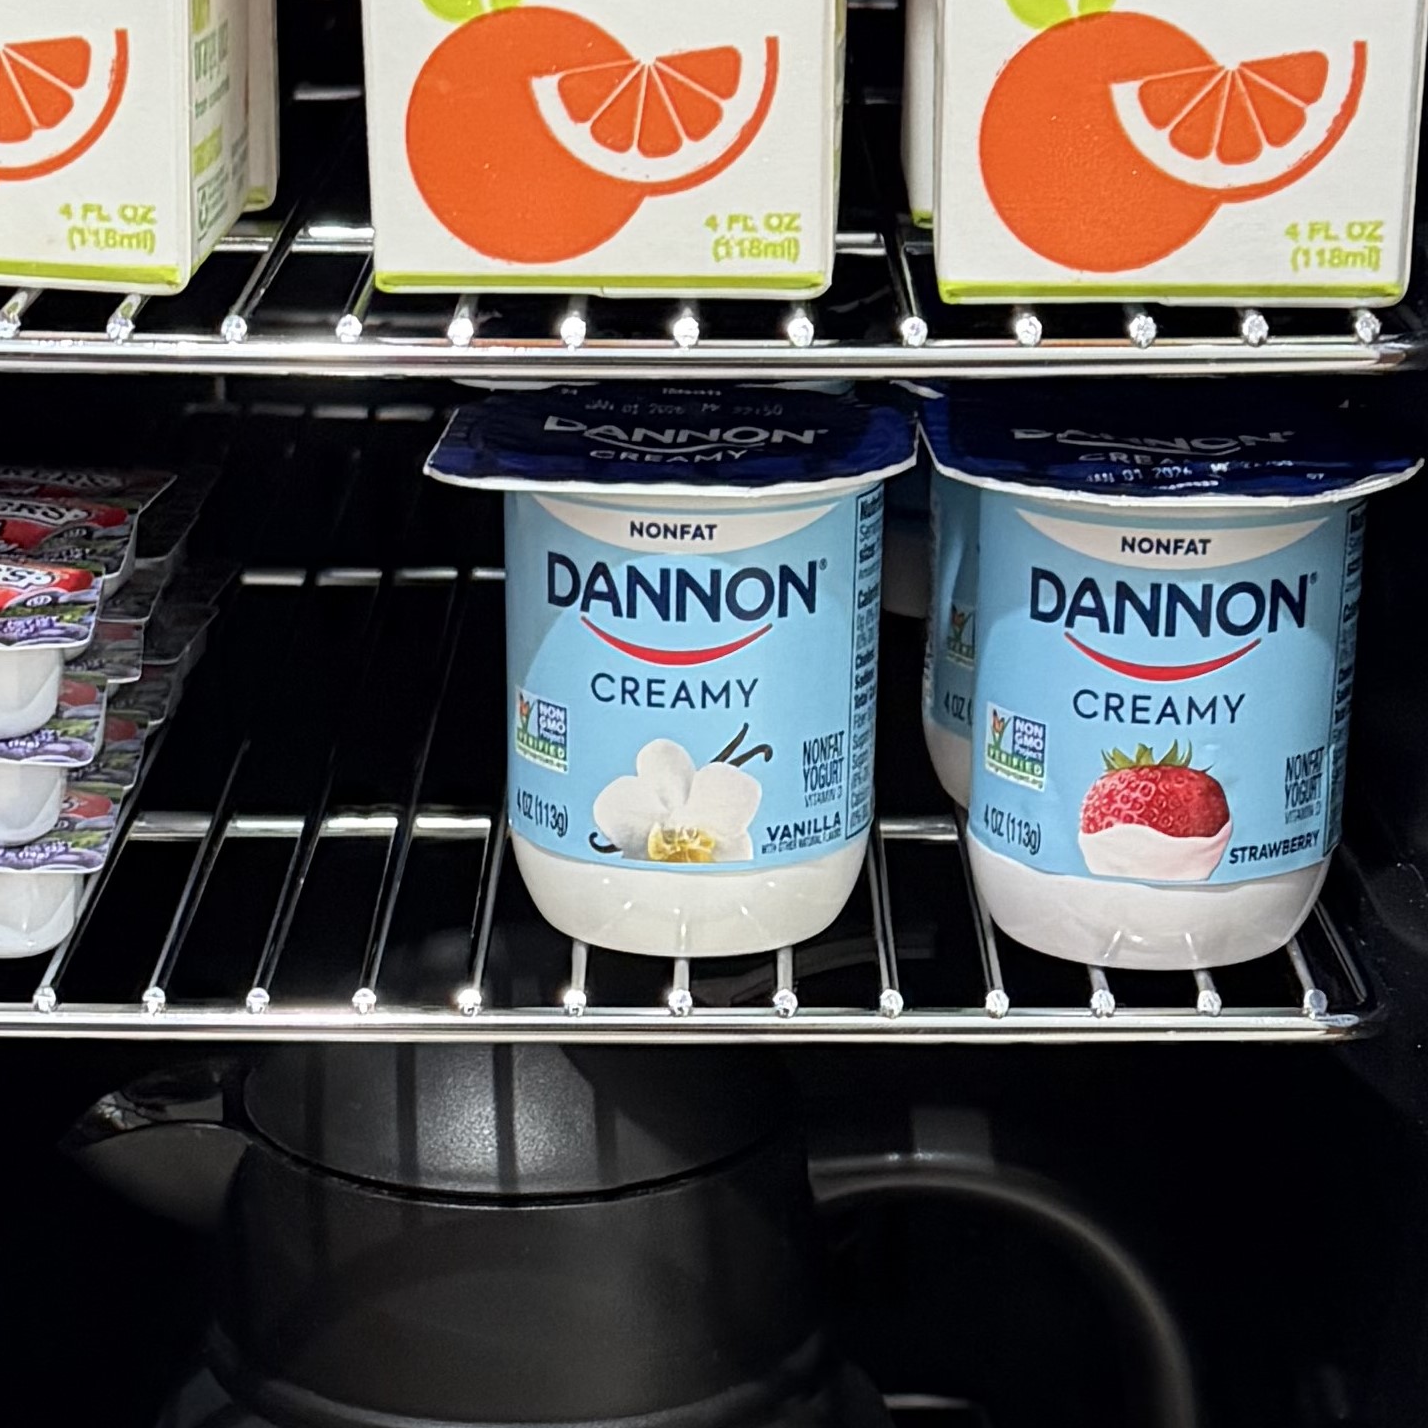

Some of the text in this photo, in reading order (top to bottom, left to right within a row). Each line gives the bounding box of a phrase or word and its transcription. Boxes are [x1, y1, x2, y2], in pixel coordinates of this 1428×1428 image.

[58, 203, 156, 225] 4 FL OZ
[703, 212, 801, 233] 4 FL OZ
[68, 226, 156, 255] (118ml)
[1284, 220, 1384, 242] 4 FL OZ
[712, 236, 800, 263] (118ml)
[1290, 245, 1381, 273] (118ml)
[544, 416, 817, 445] DANNON
[590, 449, 747, 463] CREAMY
[630, 520, 718, 541] NONFAT
[1121, 536, 1211, 555] NONFAT
[590, 672, 759, 709] CREAMY
[539, 702, 564, 722] NON
[1073, 689, 1245, 725] CREAMY
[539, 715, 565, 734] GMO
[1015, 718, 1043, 738] NON
[803, 730, 845, 766] NONFAT
[1015, 732, 1043, 751] GMO
[803, 757, 844, 793] YOGURT
[523, 790, 533, 820] OZ
[535, 795, 569, 838] (113g)
[767, 811, 841, 841] VANILLA
[991, 807, 1004, 837] OZ
[1006, 812, 1041, 855] (113g)
[1229, 829, 1320, 864] STRAWBERRY
